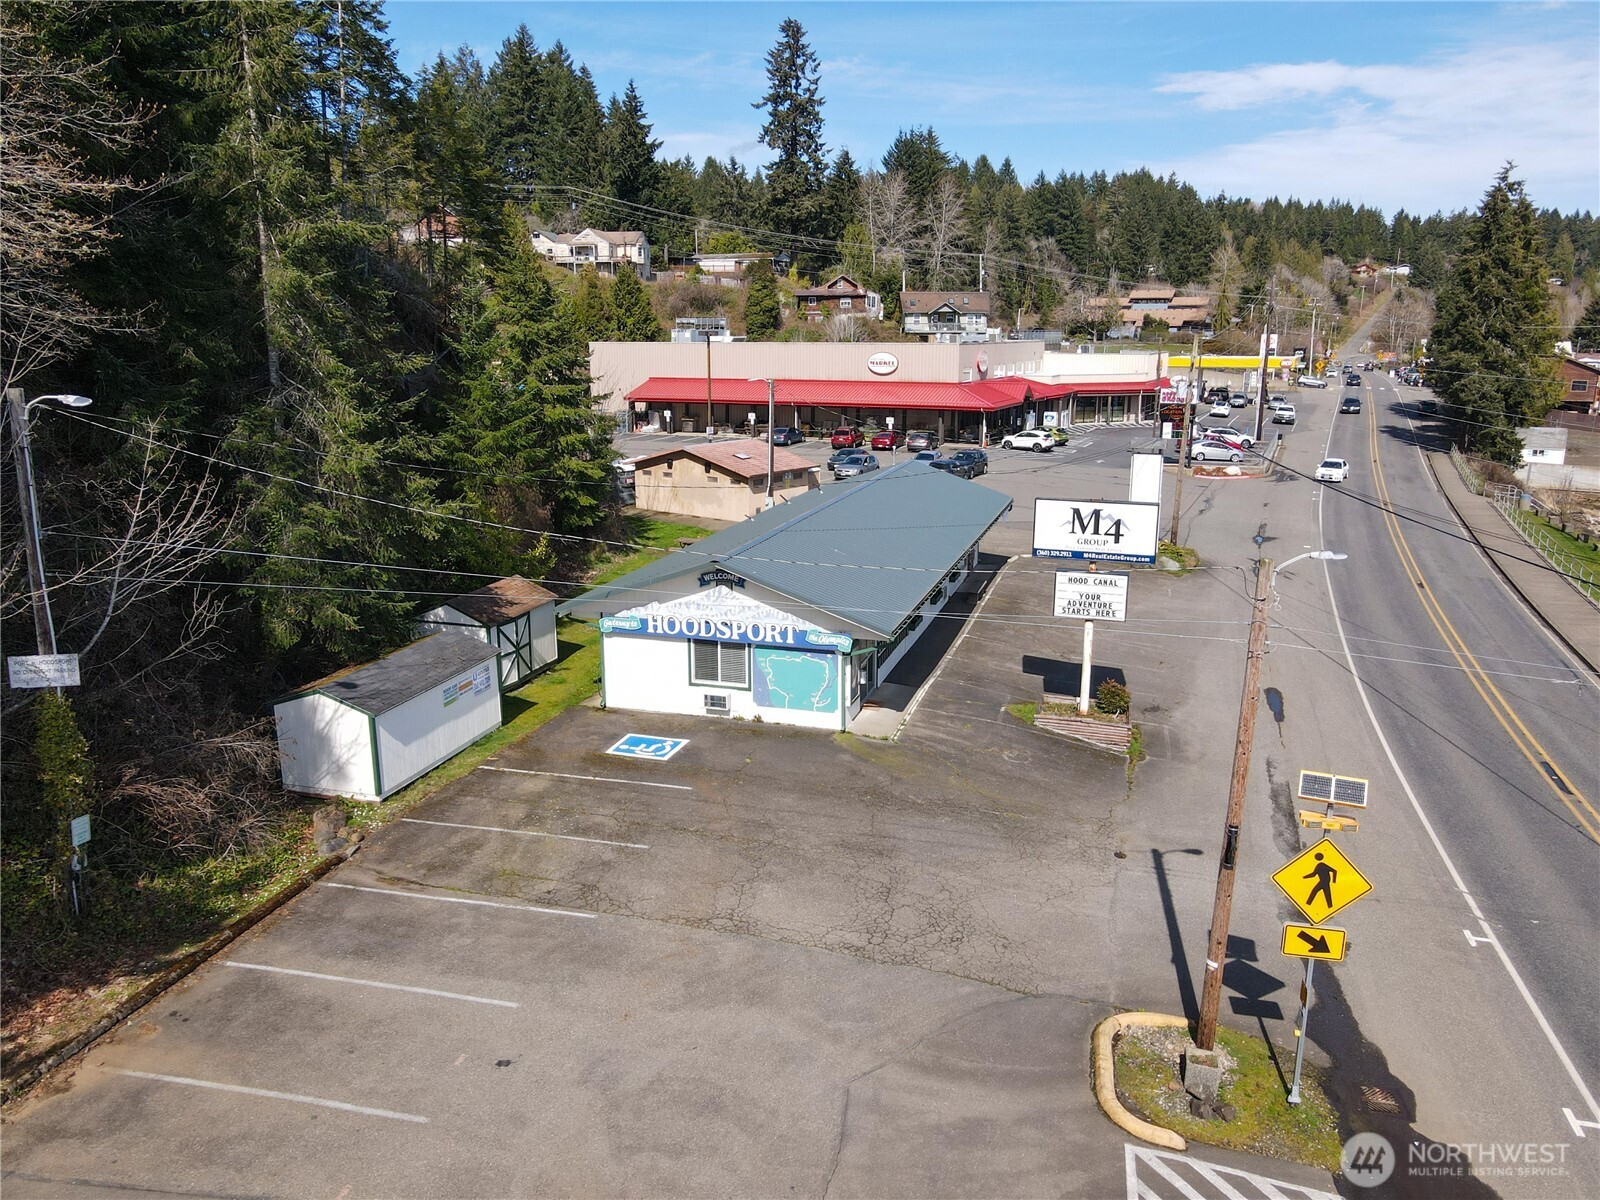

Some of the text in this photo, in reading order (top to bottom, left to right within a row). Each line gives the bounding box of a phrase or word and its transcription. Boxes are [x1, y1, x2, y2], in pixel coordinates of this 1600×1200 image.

[1068, 507, 1125, 544] M4
[1077, 538, 1109, 547] GROUP
[1083, 552, 1150, 563] M4RealEstateGroup.com
[702, 572, 739, 583] WELCOME
[1068, 577, 1118, 587] HOOD CANAL
[1079, 593, 1101, 601] YOUR
[1067, 600, 1113, 610] ADVENTURE
[1062, 607, 1117, 618] STARTS HERE
[646, 613, 800, 644] HOODSPORT
